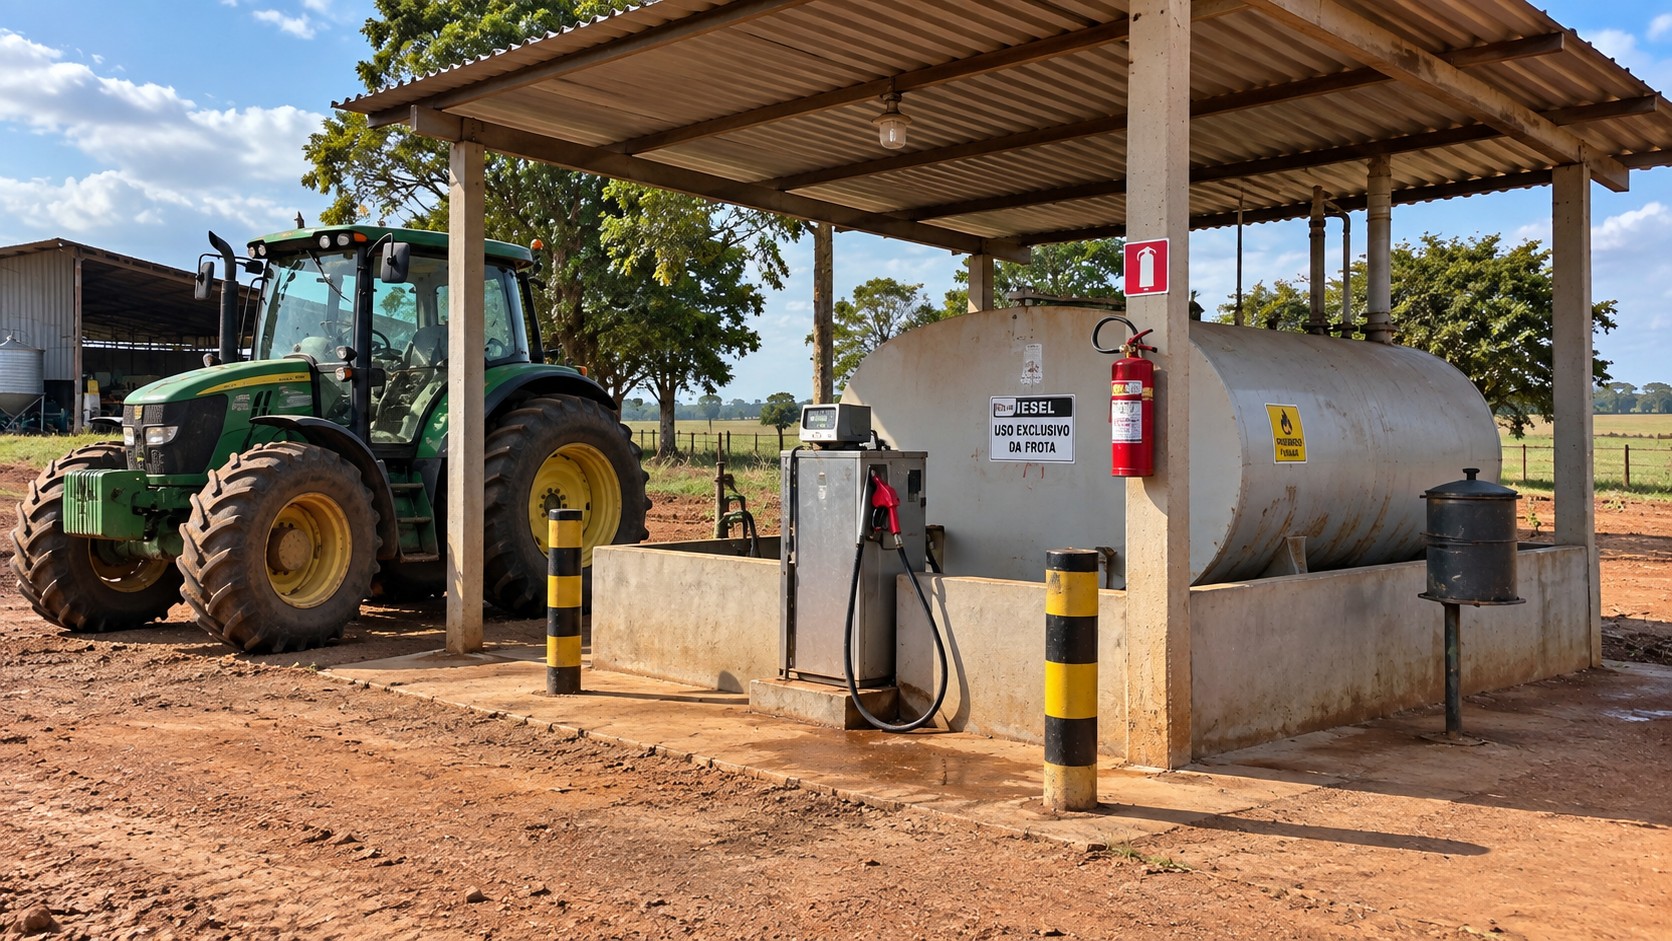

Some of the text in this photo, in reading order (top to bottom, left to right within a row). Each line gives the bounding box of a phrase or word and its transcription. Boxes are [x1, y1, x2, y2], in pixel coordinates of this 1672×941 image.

[1016, 401, 1055, 414] IESEL
[994, 424, 1070, 436] USO EXCLUSIVO
[1009, 441, 1056, 453] DA FROTA
